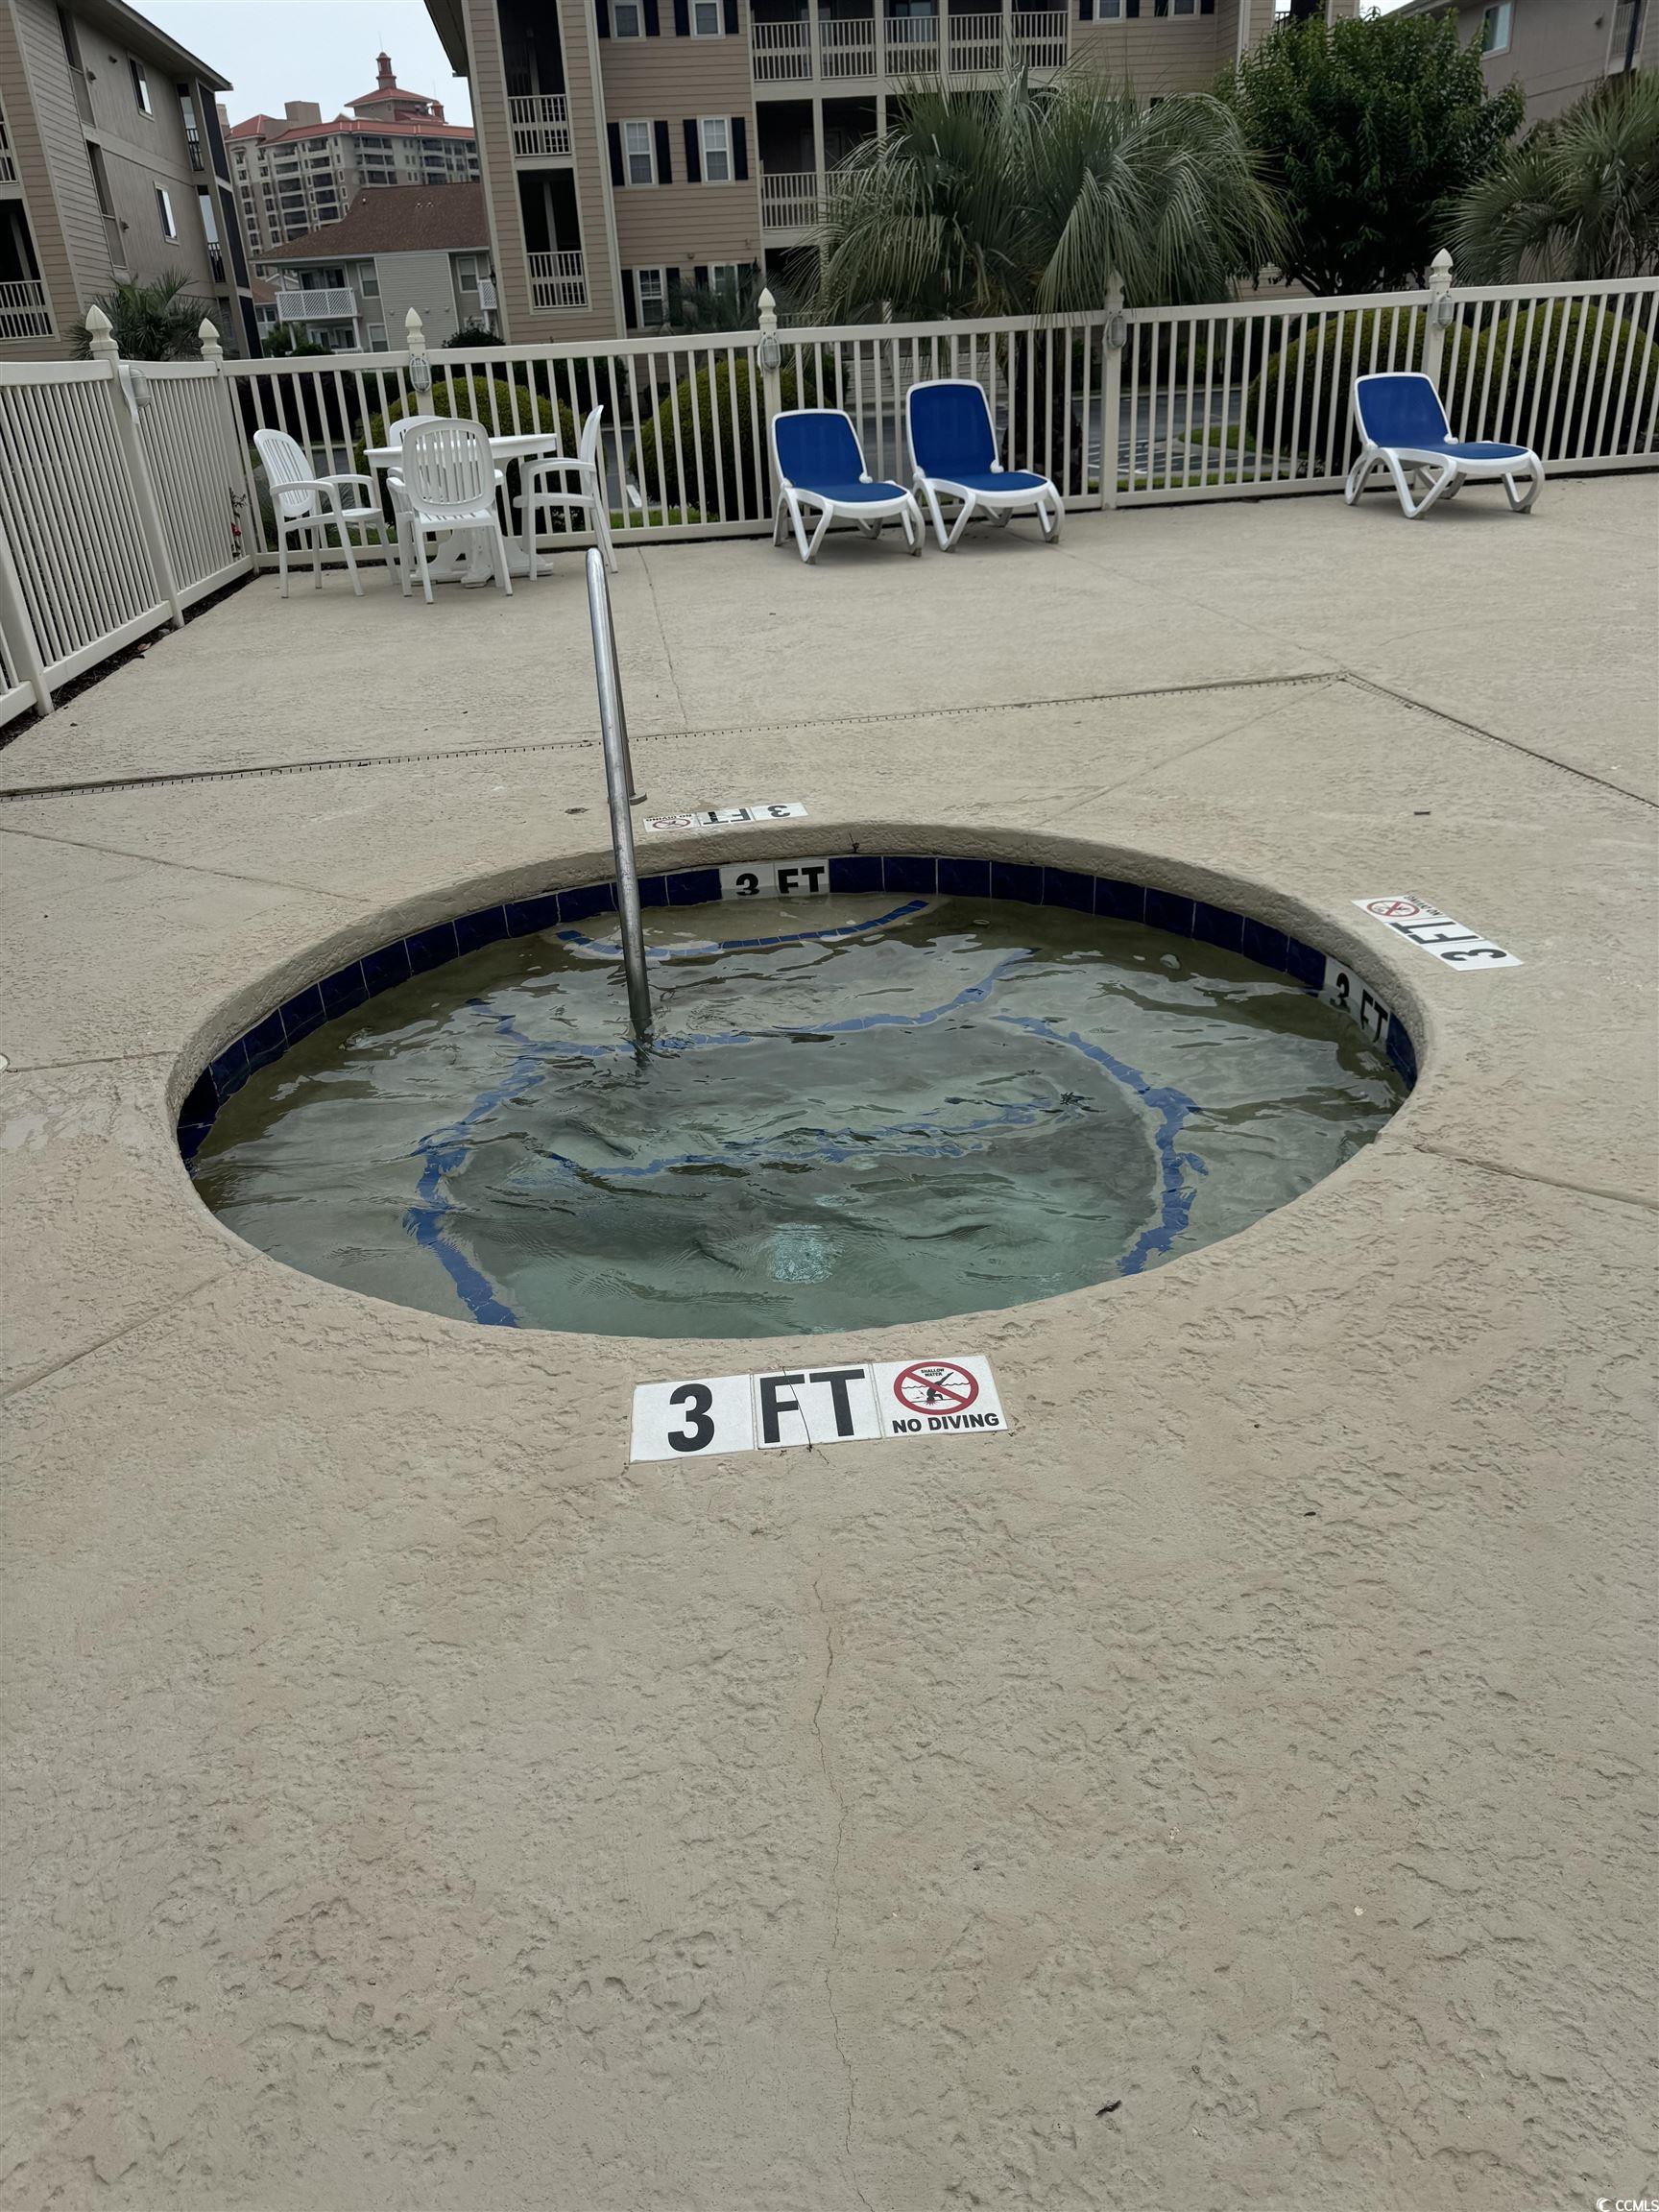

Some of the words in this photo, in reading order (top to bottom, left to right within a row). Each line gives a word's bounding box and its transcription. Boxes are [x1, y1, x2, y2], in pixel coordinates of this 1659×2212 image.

[703, 807, 752, 825] FT
[767, 805, 791, 818] 3
[735, 873, 760, 896] 3
[777, 866, 825, 894] FT
[1389, 921, 1479, 945] FT
[1440, 948, 1508, 962] 3
[1330, 973, 1350, 1009] 3
[1360, 989, 1388, 1043] FT
[667, 1383, 715, 1453] 3
[759, 1368, 866, 1444] FT
[892, 1418, 922, 1433] NO
[927, 1413, 999, 1431] DIVING
